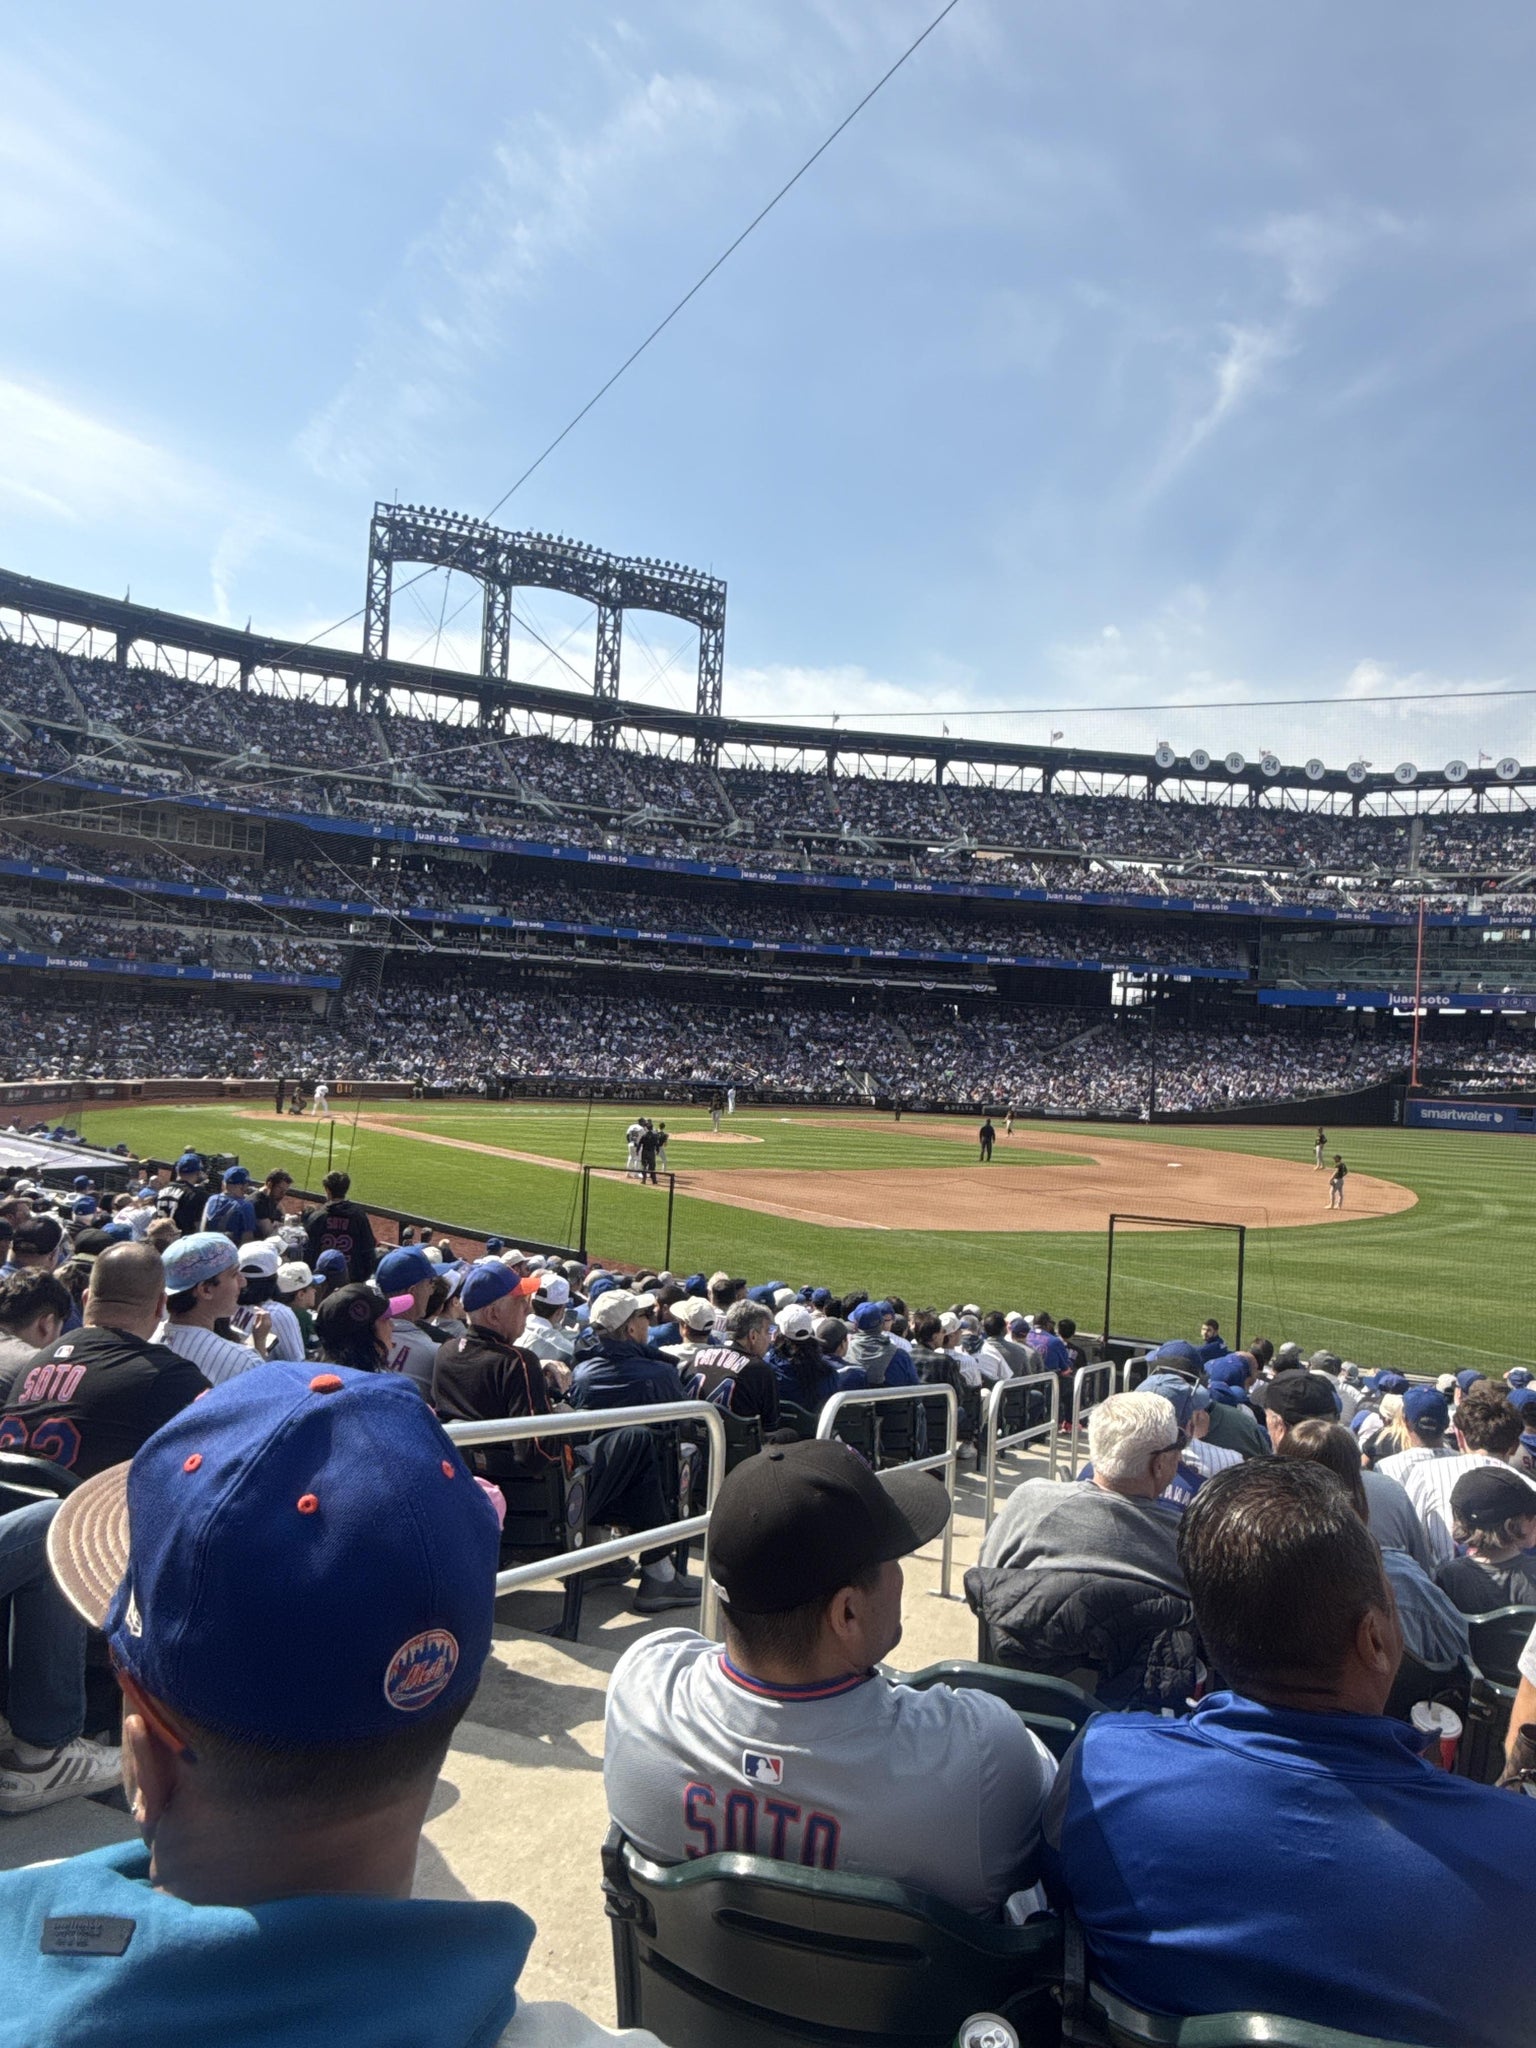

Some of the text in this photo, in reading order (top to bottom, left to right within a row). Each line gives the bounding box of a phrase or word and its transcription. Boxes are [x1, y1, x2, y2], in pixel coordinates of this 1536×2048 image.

[1162, 752, 1169, 762] 5
[1196, 755, 1205, 765] 18
[1231, 758, 1240, 768] 16
[1264, 761, 1277, 770] 24
[1310, 764, 1320, 775] 17
[1351, 768, 1362, 778] 36
[1401, 769, 1412, 778] 31
[1450, 766, 1462, 776] 41
[1502, 763, 1514, 774] 14
[415, 830, 436, 841] juan
[588, 851, 607, 861] juan
[741, 870, 757, 879] juan
[1489, 915, 1510, 925] juan
[46, 956, 88, 968] juan soto
[212, 970, 252, 980] juan soto
[1336, 993, 1347, 1001] 22
[1388, 993, 1450, 1005] juan soto
[1421, 1108, 1492, 1122] smartwater
[693, 1347, 751, 1374] PAYTON
[18, 1363, 87, 1403] SOTO
[396, 1655, 446, 1691] Mets
[683, 1780, 841, 1871] SOTO
